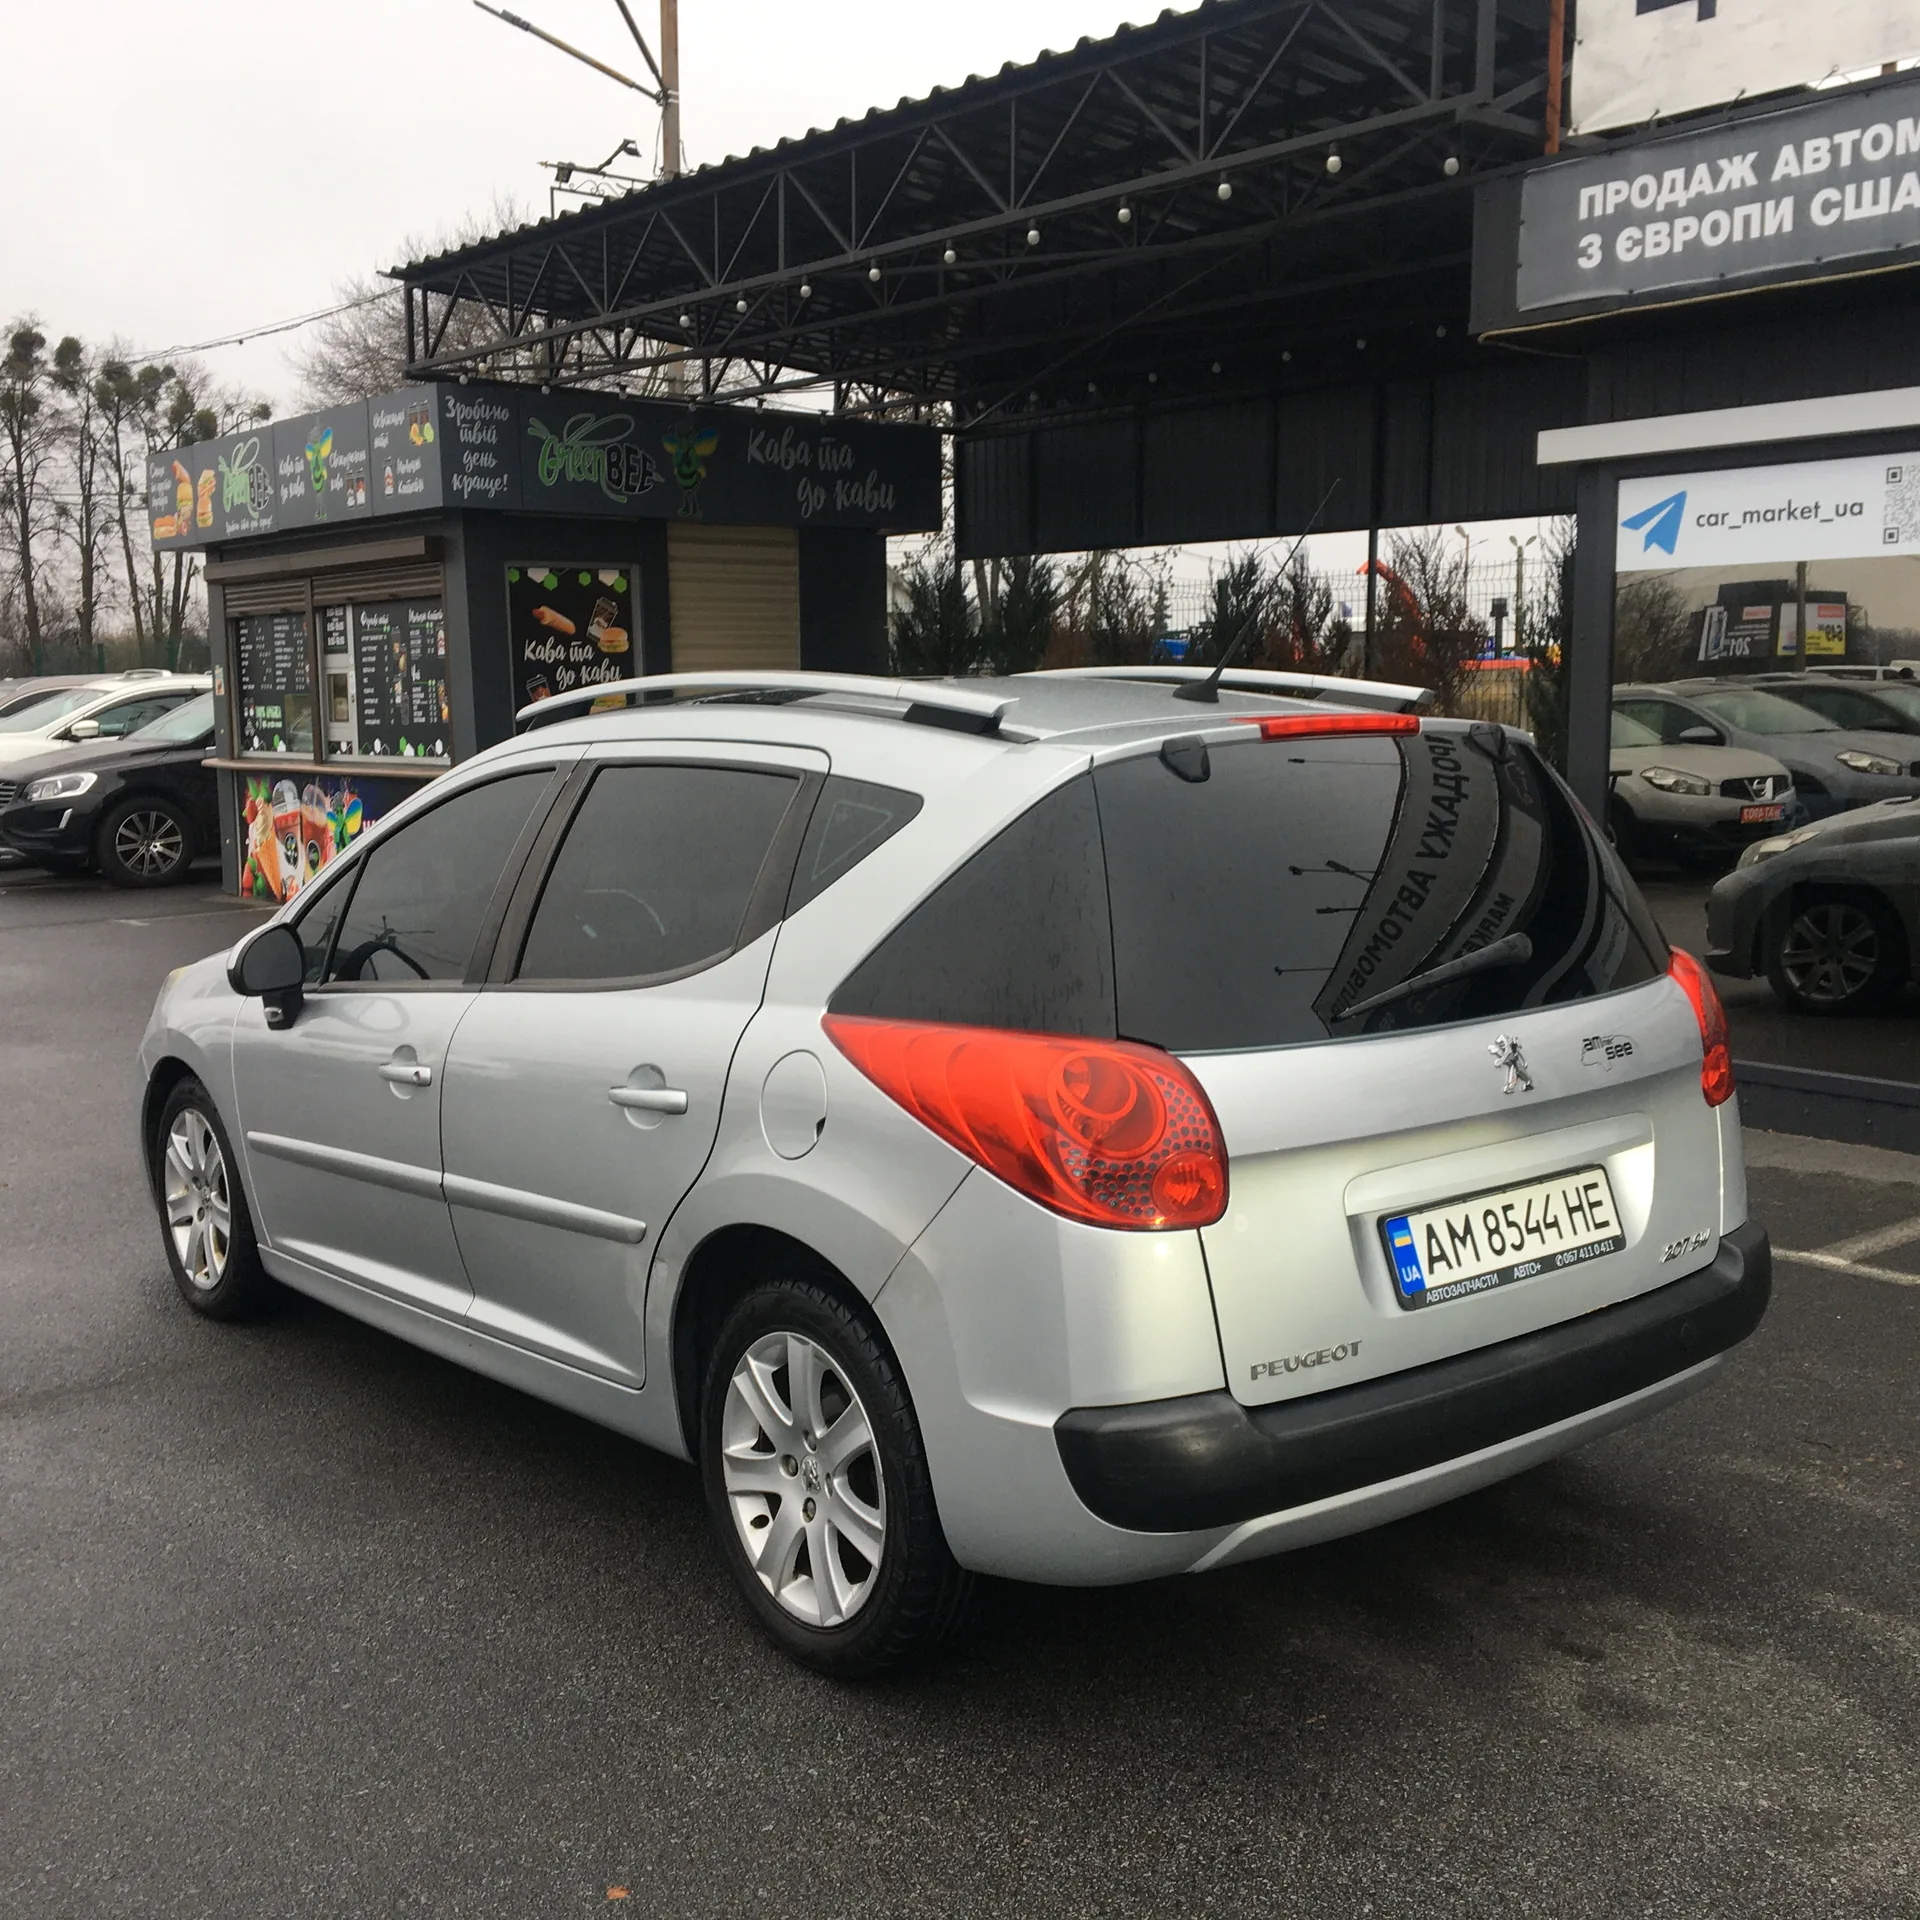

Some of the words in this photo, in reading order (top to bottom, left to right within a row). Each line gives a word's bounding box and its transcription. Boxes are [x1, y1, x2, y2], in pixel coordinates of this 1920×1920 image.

[1578, 150, 1760, 221] ПРОДАЖ
[1576, 232, 1603, 269] З
[1615, 194, 1795, 263] ЄВРОПИ
[1809, 170, 1920, 227] США
[444, 395, 511, 427] Зробимо
[459, 420, 499, 445] твій
[746, 425, 813, 470] Кава
[817, 436, 855, 472] та
[462, 449, 498, 474] день
[450, 472, 509, 500] краще!
[796, 476, 827, 519] до
[833, 468, 896, 513] кави
[1695, 498, 1864, 530] car_market_ua
[523, 635, 567, 664] Кава
[569, 640, 595, 662] та
[556, 664, 576, 690] до
[580, 658, 622, 685] кави
[1425, 1213, 1481, 1275] AM
[1482, 1193, 1563, 1257] 8544
[1562, 1181, 1611, 1236] HE
[1659, 1236, 1691, 1264] 207
[1689, 1227, 1711, 1253] SW
[1401, 1264, 1422, 1283] UA
[1426, 1272, 1499, 1303] АВТОЗАПЧАСТИ
[1513, 1262, 1542, 1280] АВТО+
[1563, 1249, 1578, 1264] 067
[1579, 1245, 1594, 1258] 411
[1600, 1239, 1615, 1253] 411
[1250, 1338, 1363, 1381] PEUGEOT
